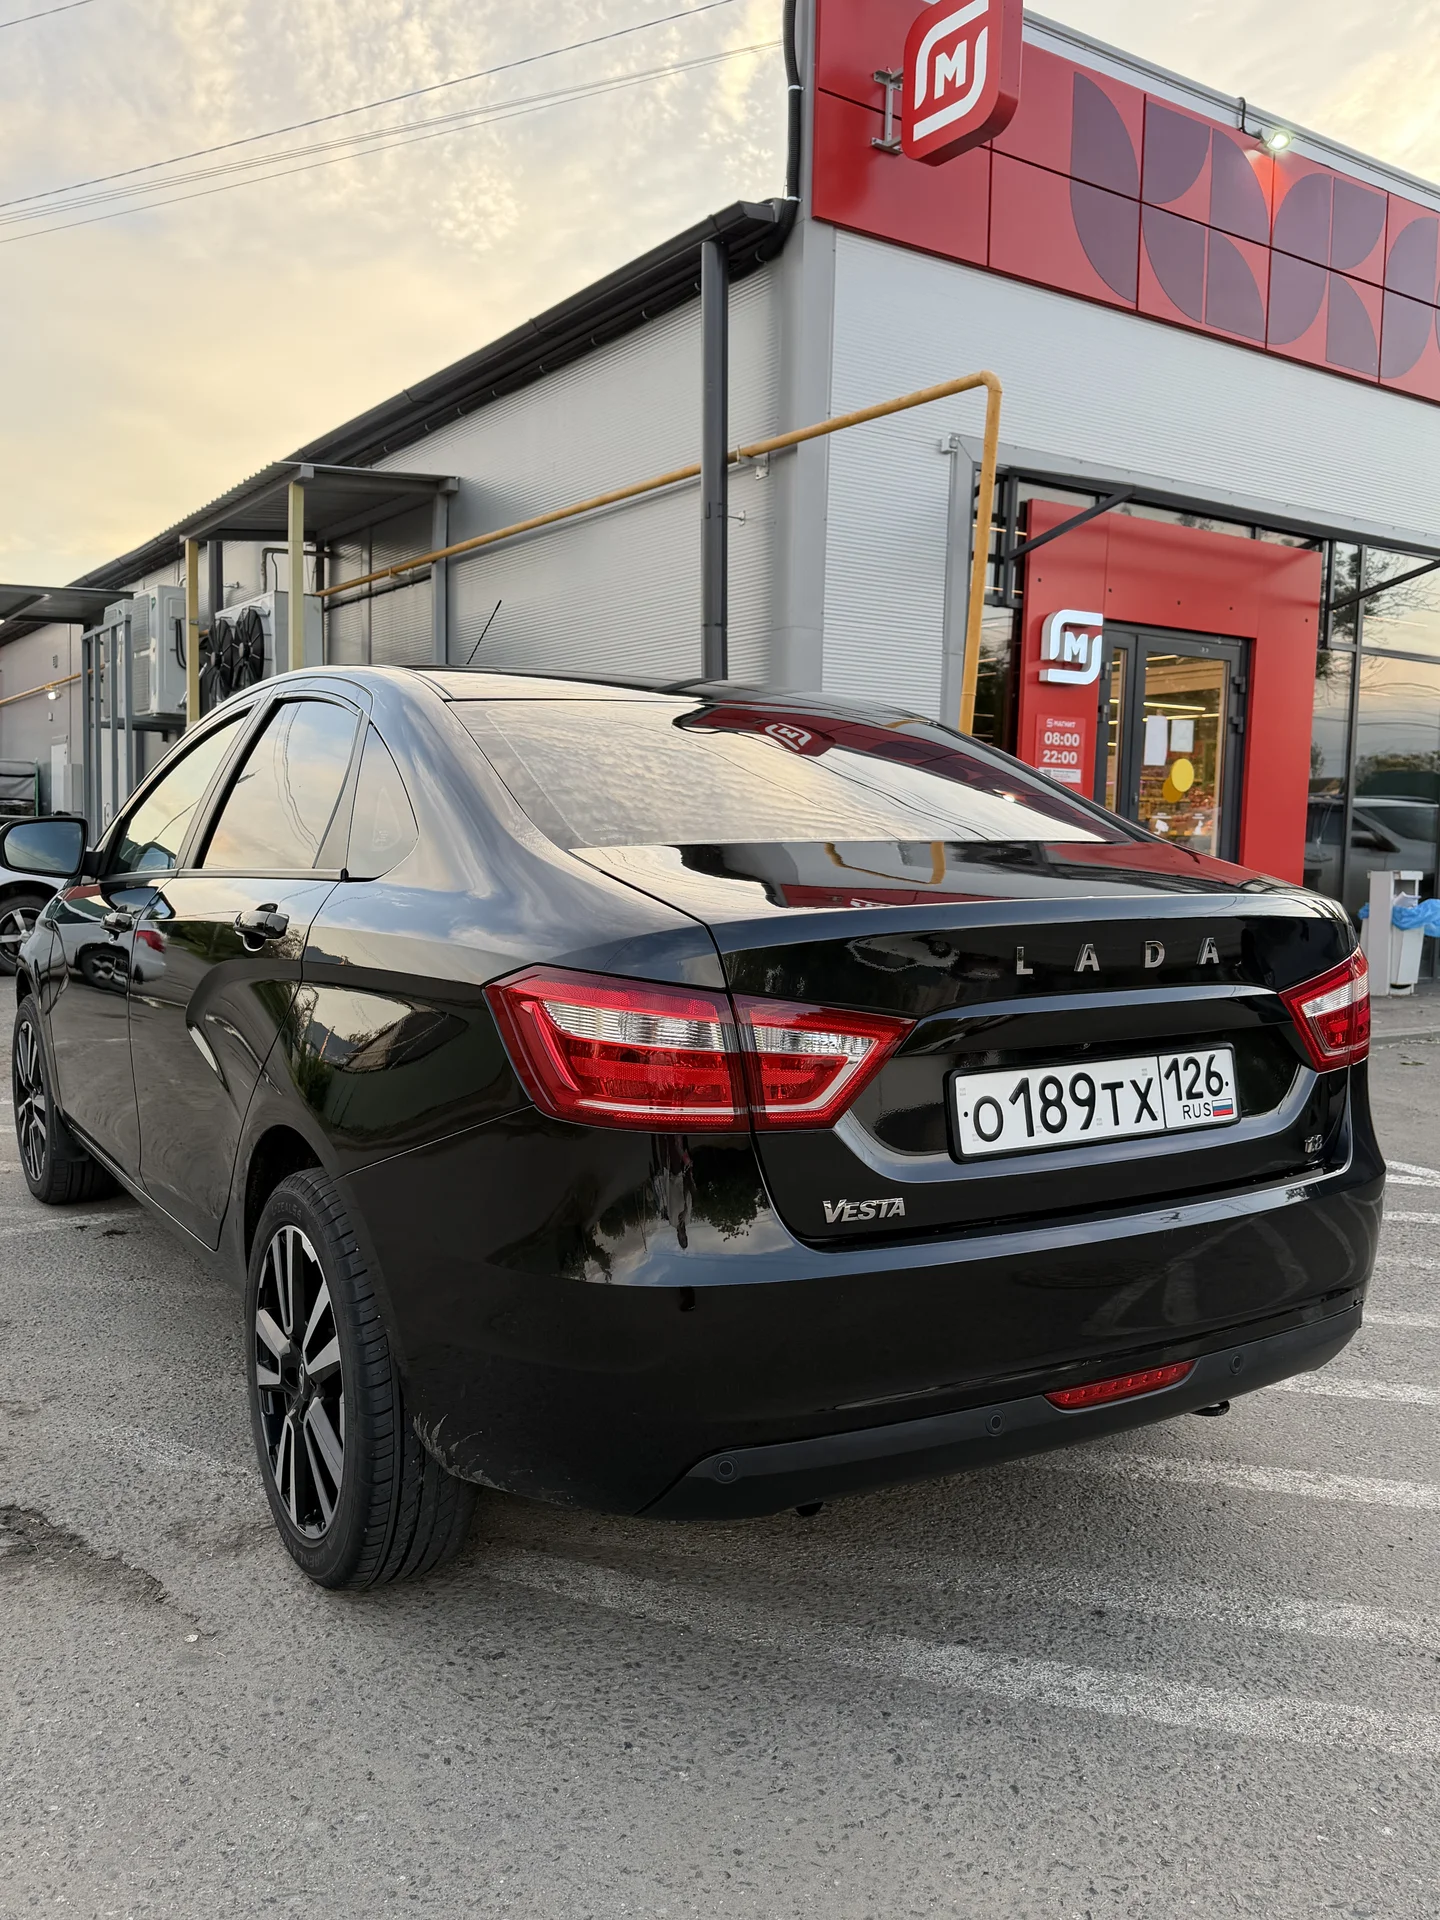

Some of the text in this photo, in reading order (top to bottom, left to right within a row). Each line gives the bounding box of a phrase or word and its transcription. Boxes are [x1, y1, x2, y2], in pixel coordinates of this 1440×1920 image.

[1044, 731, 1080, 747] 08:00
[1042, 749, 1078, 765] 22:00
[1016, 937, 1220, 975] LADA
[1164, 1053, 1224, 1101] 126
[1182, 1102, 1212, 1120] RUS
[822, 1197, 906, 1224] VESTA
